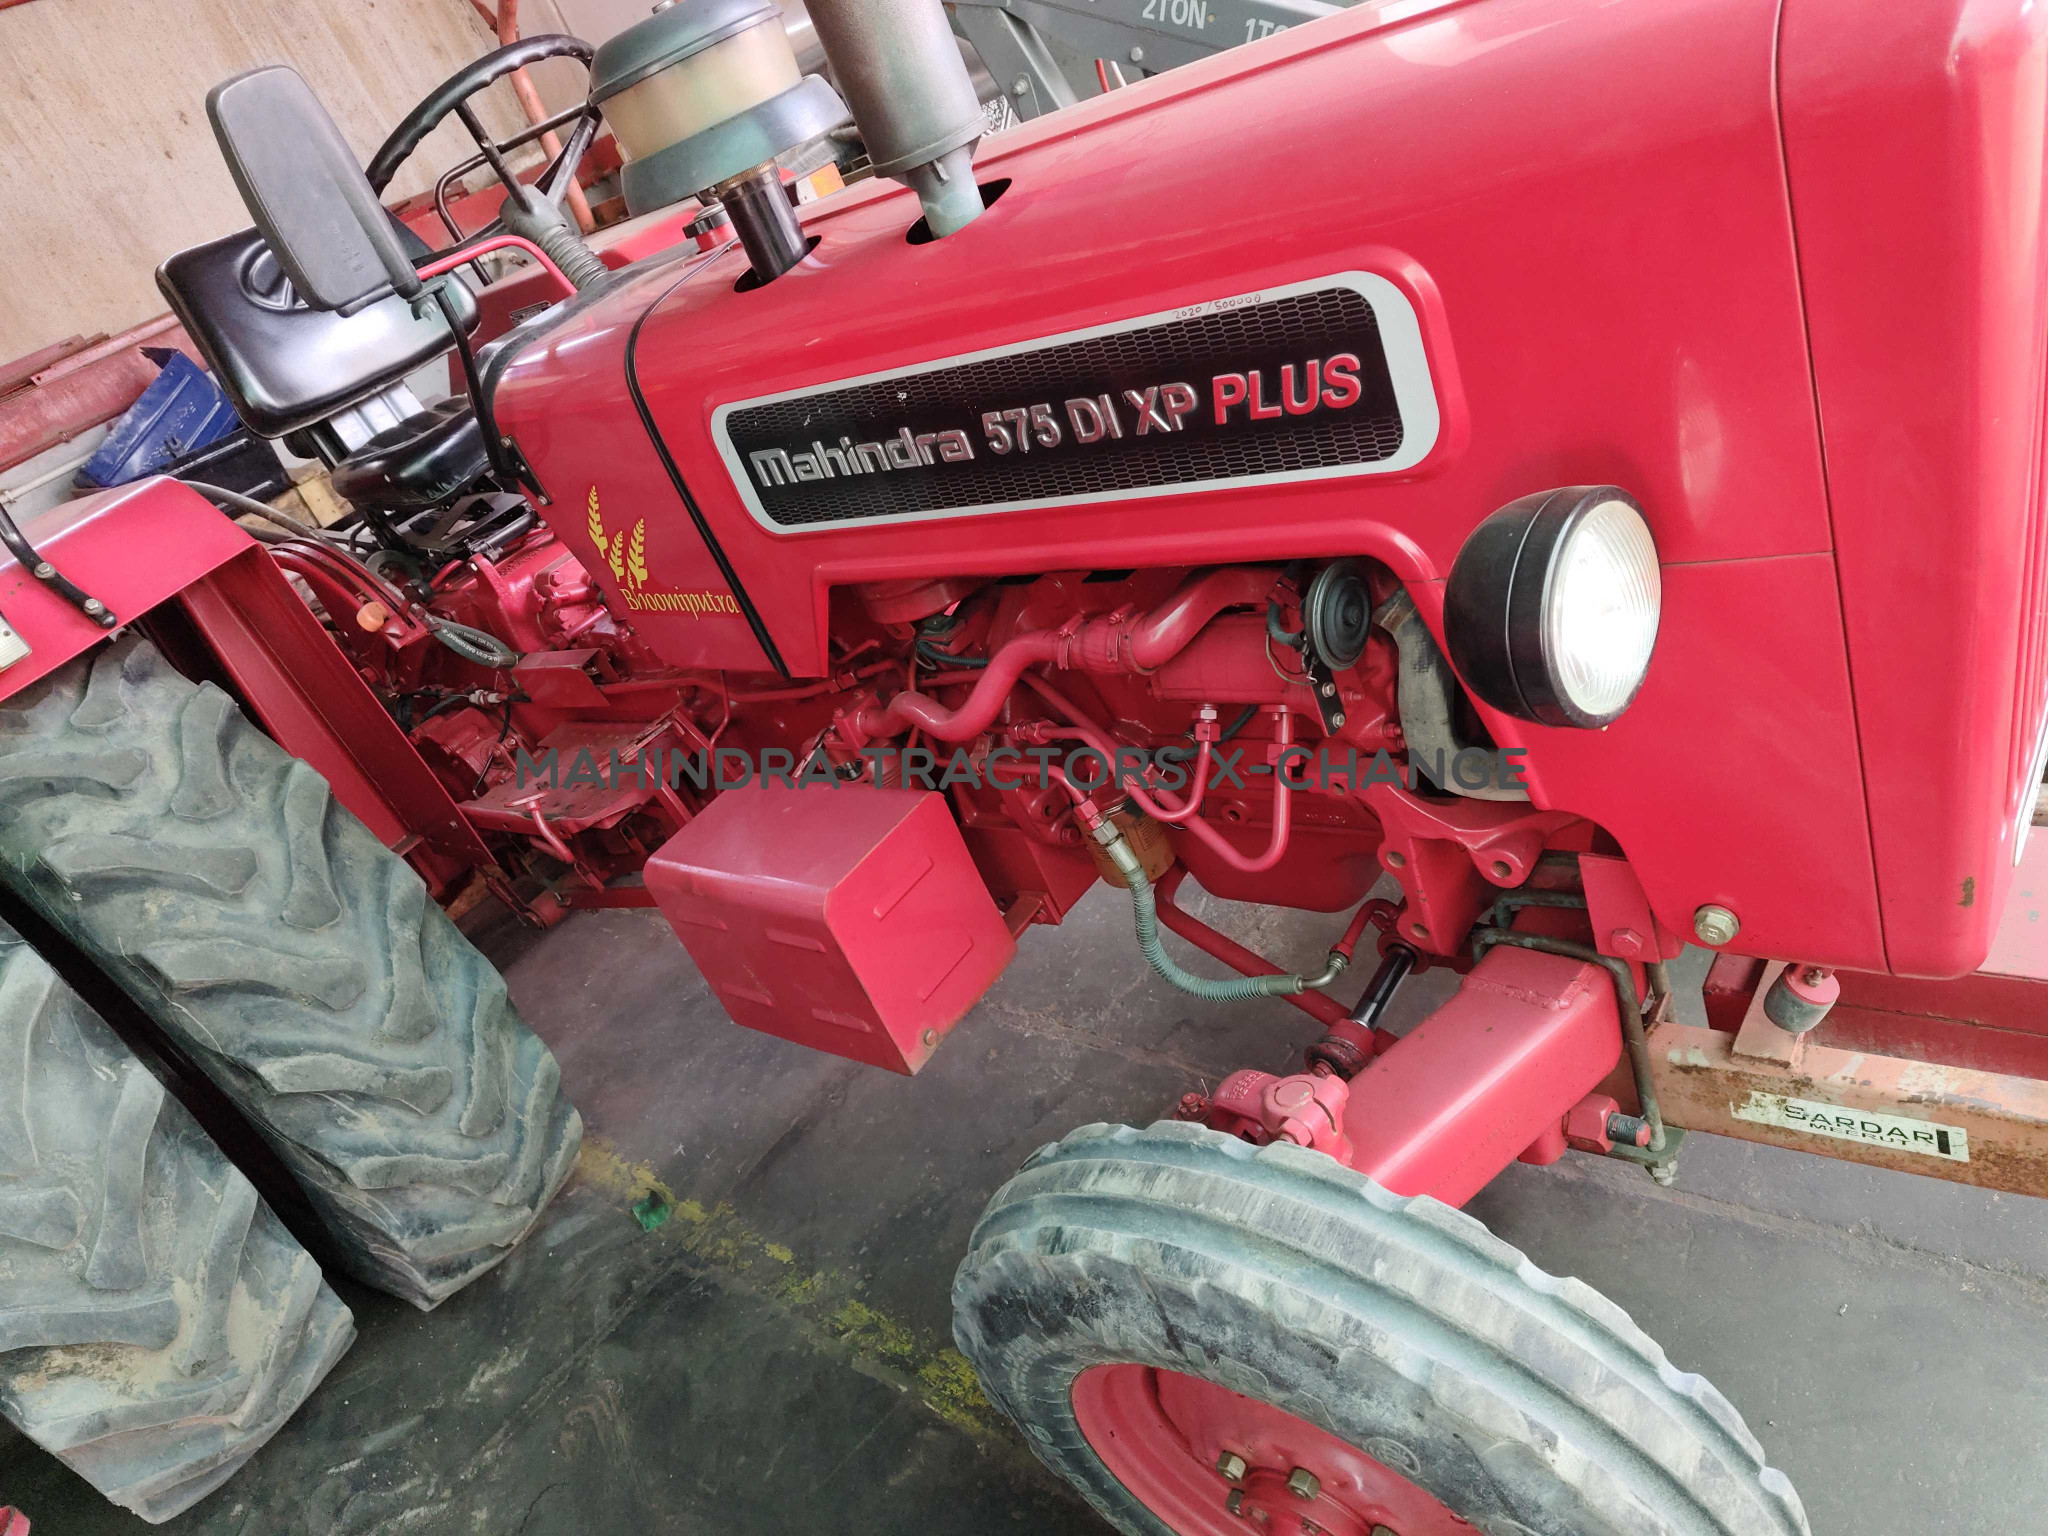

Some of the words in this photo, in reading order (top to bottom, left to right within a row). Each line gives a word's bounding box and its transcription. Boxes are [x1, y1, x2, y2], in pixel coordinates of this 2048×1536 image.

[1142, 0, 1208, 29] 2TON
[982, 403, 1061, 455] 575
[1065, 394, 1123, 444] DI
[1124, 382, 1198, 436] XP
[1212, 353, 1361, 425] PLUS
[619, 585, 740, 621] Bhoomiputra
[1785, 1104, 1934, 1145] SARDAR
[1809, 1122, 1910, 1146] MEERUT
